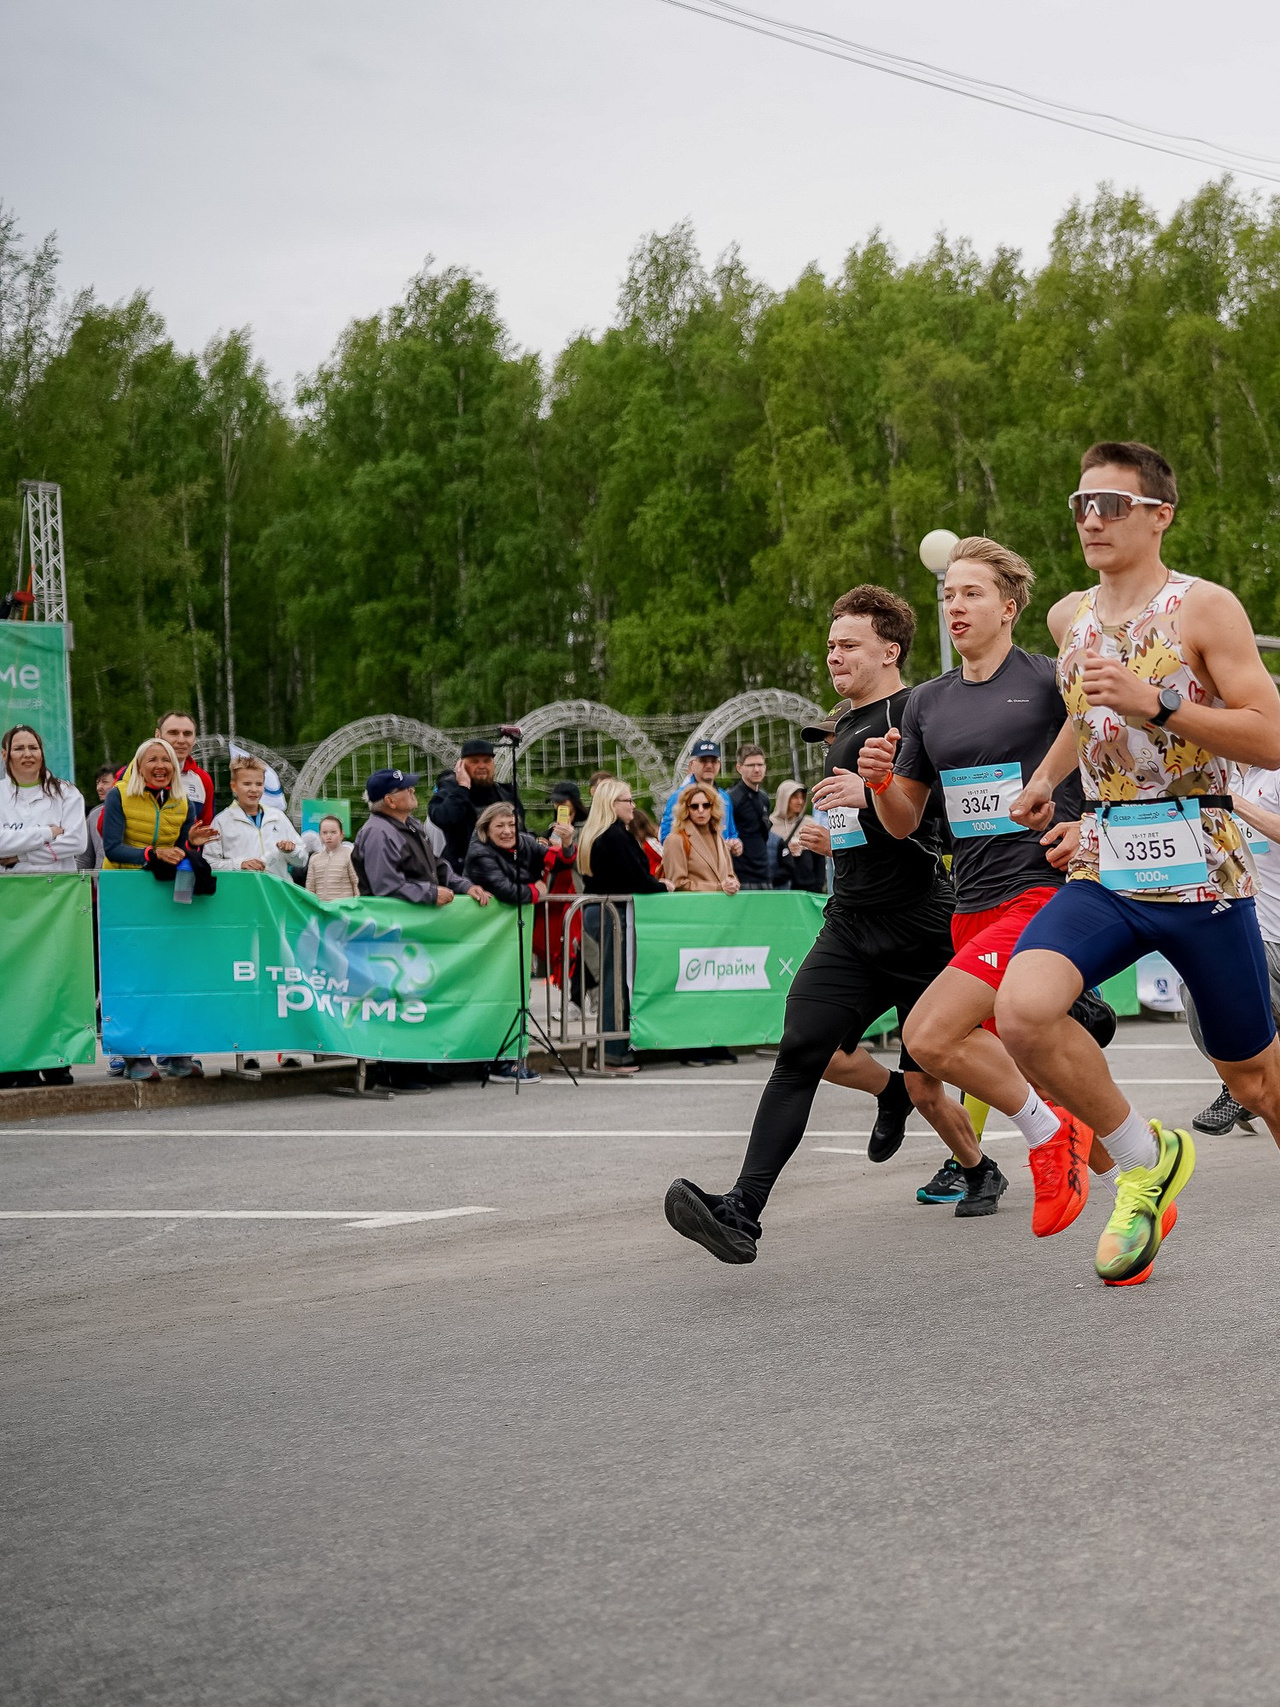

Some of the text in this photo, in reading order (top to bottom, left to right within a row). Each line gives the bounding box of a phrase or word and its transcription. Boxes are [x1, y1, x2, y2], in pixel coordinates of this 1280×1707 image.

[961, 795, 1000, 814] 3347
[1124, 838, 1176, 860] 3355
[233, 960, 256, 982] В
[704, 959, 756, 979] Прайм
